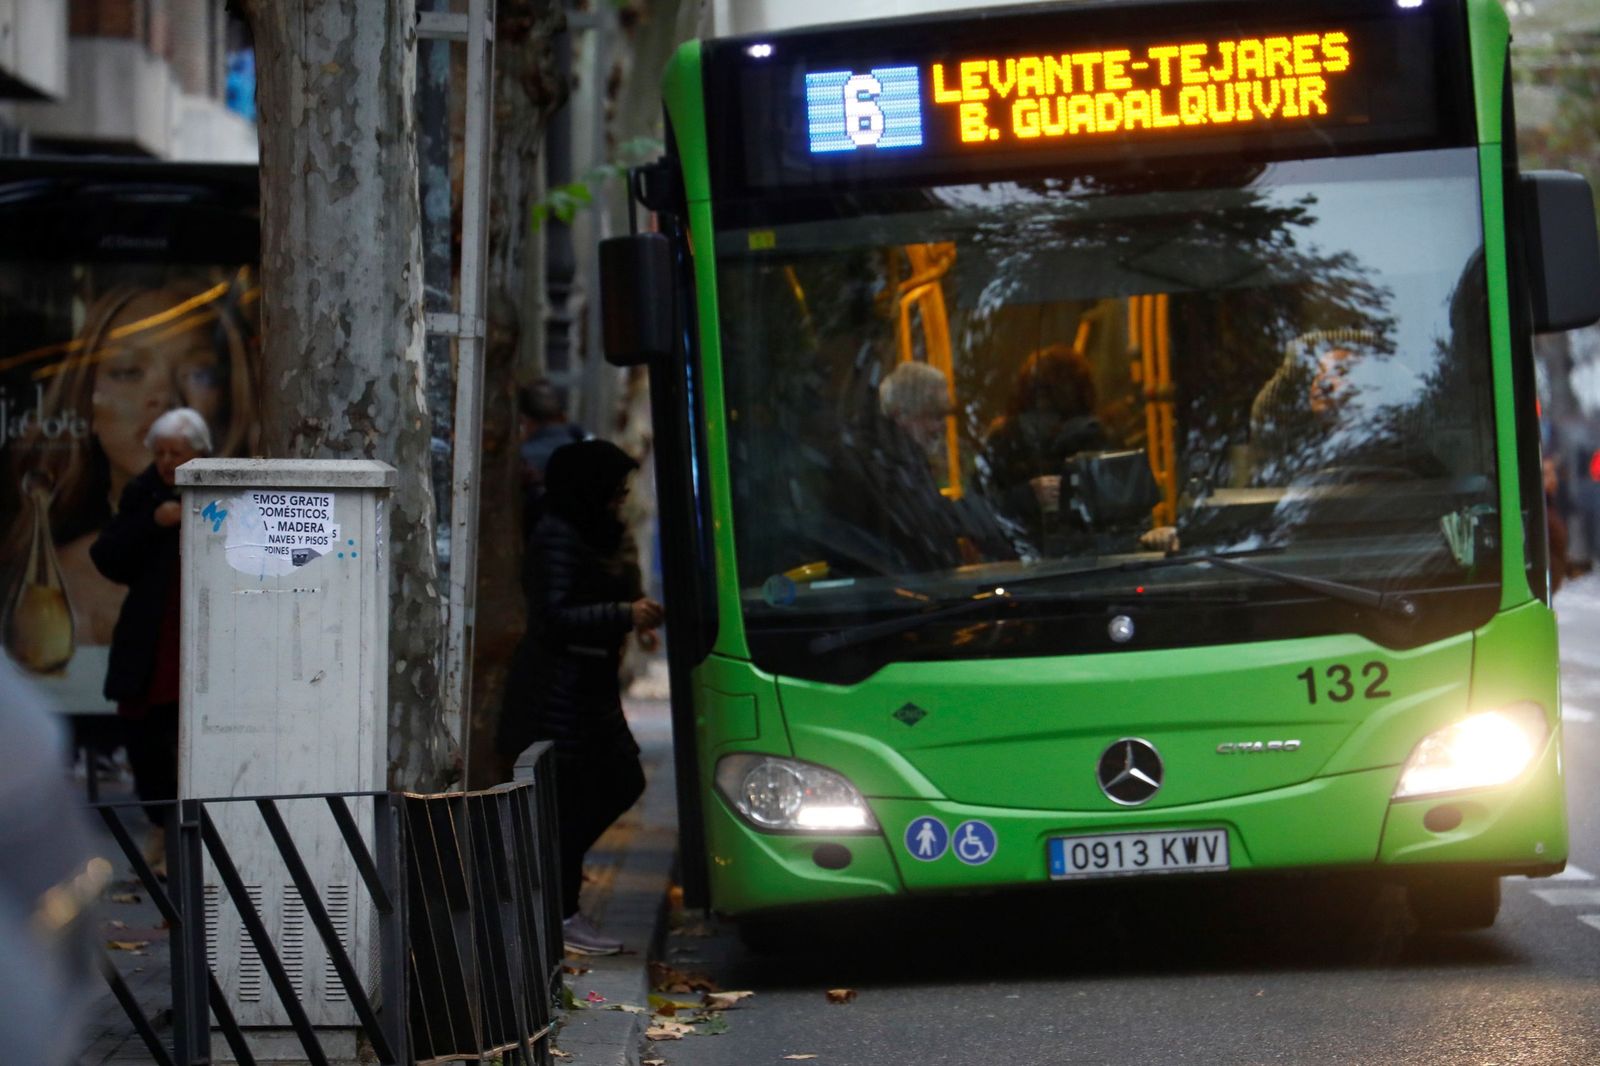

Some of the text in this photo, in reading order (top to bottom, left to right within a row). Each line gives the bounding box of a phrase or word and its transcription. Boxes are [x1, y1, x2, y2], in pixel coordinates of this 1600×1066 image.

[933, 32, 1349, 103] LEVANTE-TEJARES
[844, 74, 884, 145] 6
[960, 75, 1327, 142] B. GUADALQUIVIR
[289, 495, 329, 507] GRATIS
[268, 534, 328, 546] NAVES Y PISOS
[277, 521, 325, 533] MADERA
[1297, 661, 1391, 704] 132
[1072, 835, 1218, 869] 0913 KWV
